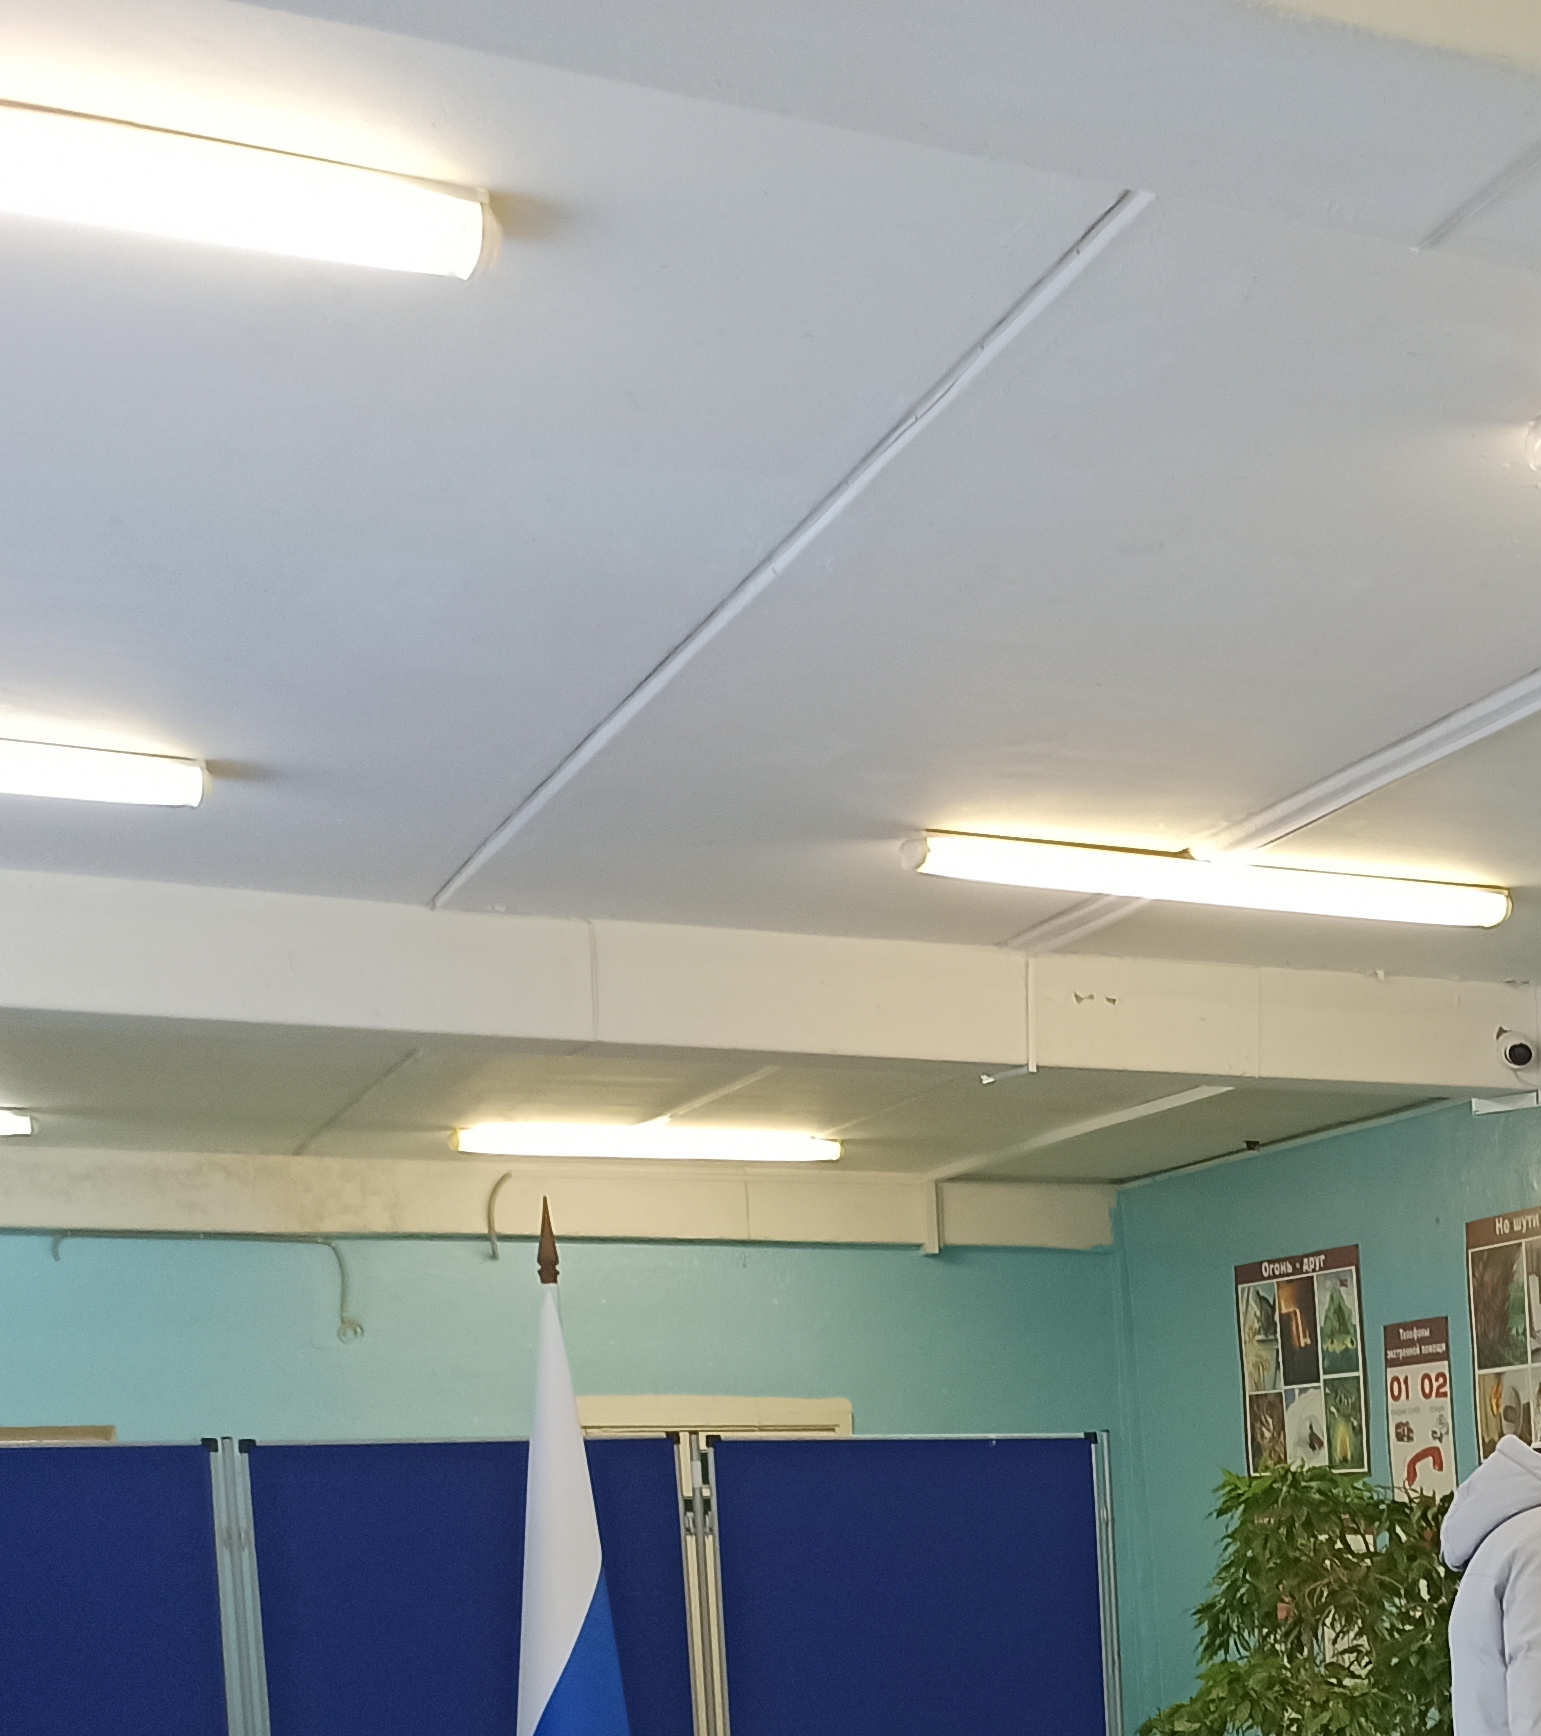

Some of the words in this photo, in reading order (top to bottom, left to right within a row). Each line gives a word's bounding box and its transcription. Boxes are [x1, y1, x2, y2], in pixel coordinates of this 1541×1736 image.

[1261, 1260, 1293, 1278] Огонь
[1302, 1254, 1326, 1273] друг
[1389, 1374, 1410, 1402] 01
[1420, 1371, 1448, 1400] 02
